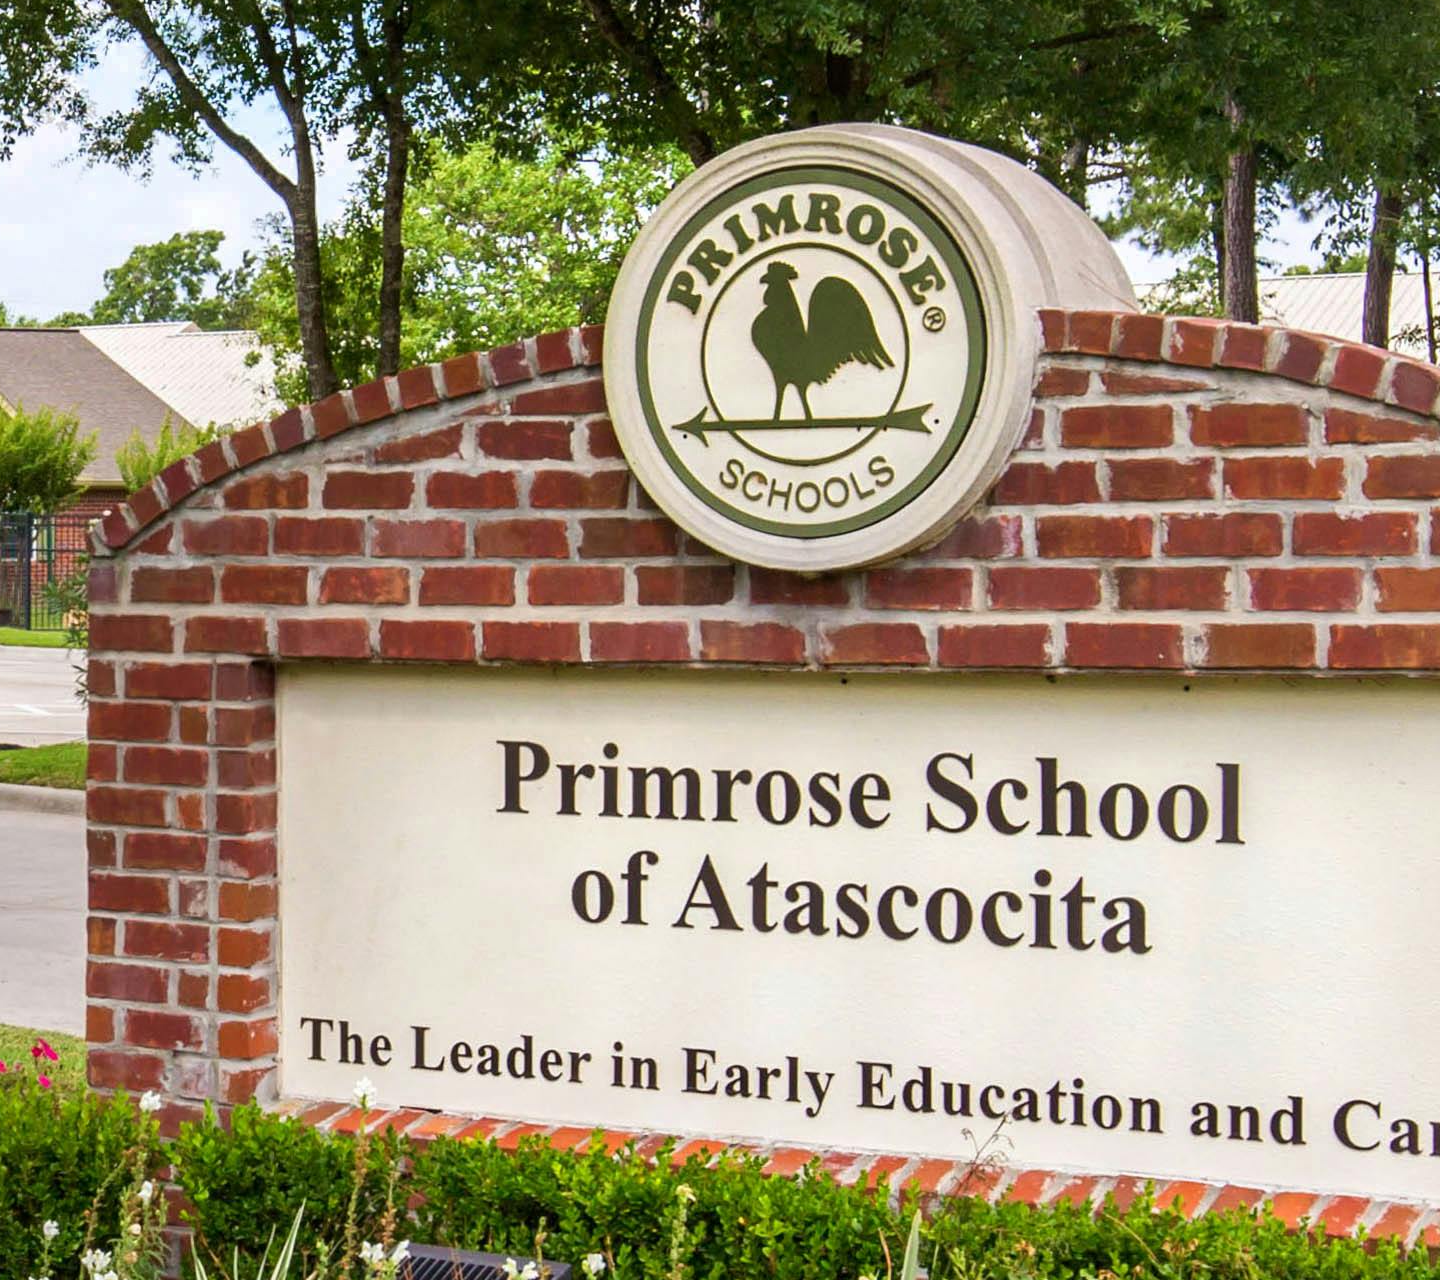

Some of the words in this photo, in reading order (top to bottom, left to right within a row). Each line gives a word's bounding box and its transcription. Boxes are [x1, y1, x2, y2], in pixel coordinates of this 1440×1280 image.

[719, 455, 896, 514] SCHOOLS
[495, 740, 891, 830] Primrose
[926, 752, 1245, 847] School
[571, 849, 660, 927] of
[671, 854, 1153, 956] Atascocita
[300, 1017, 392, 1068] The
[410, 1025, 592, 1086] Leader
[611, 1041, 660, 1091] in
[681, 1047, 835, 1119] Early
[856, 1061, 1164, 1135] Education
[1190, 1095, 1308, 1147] and
